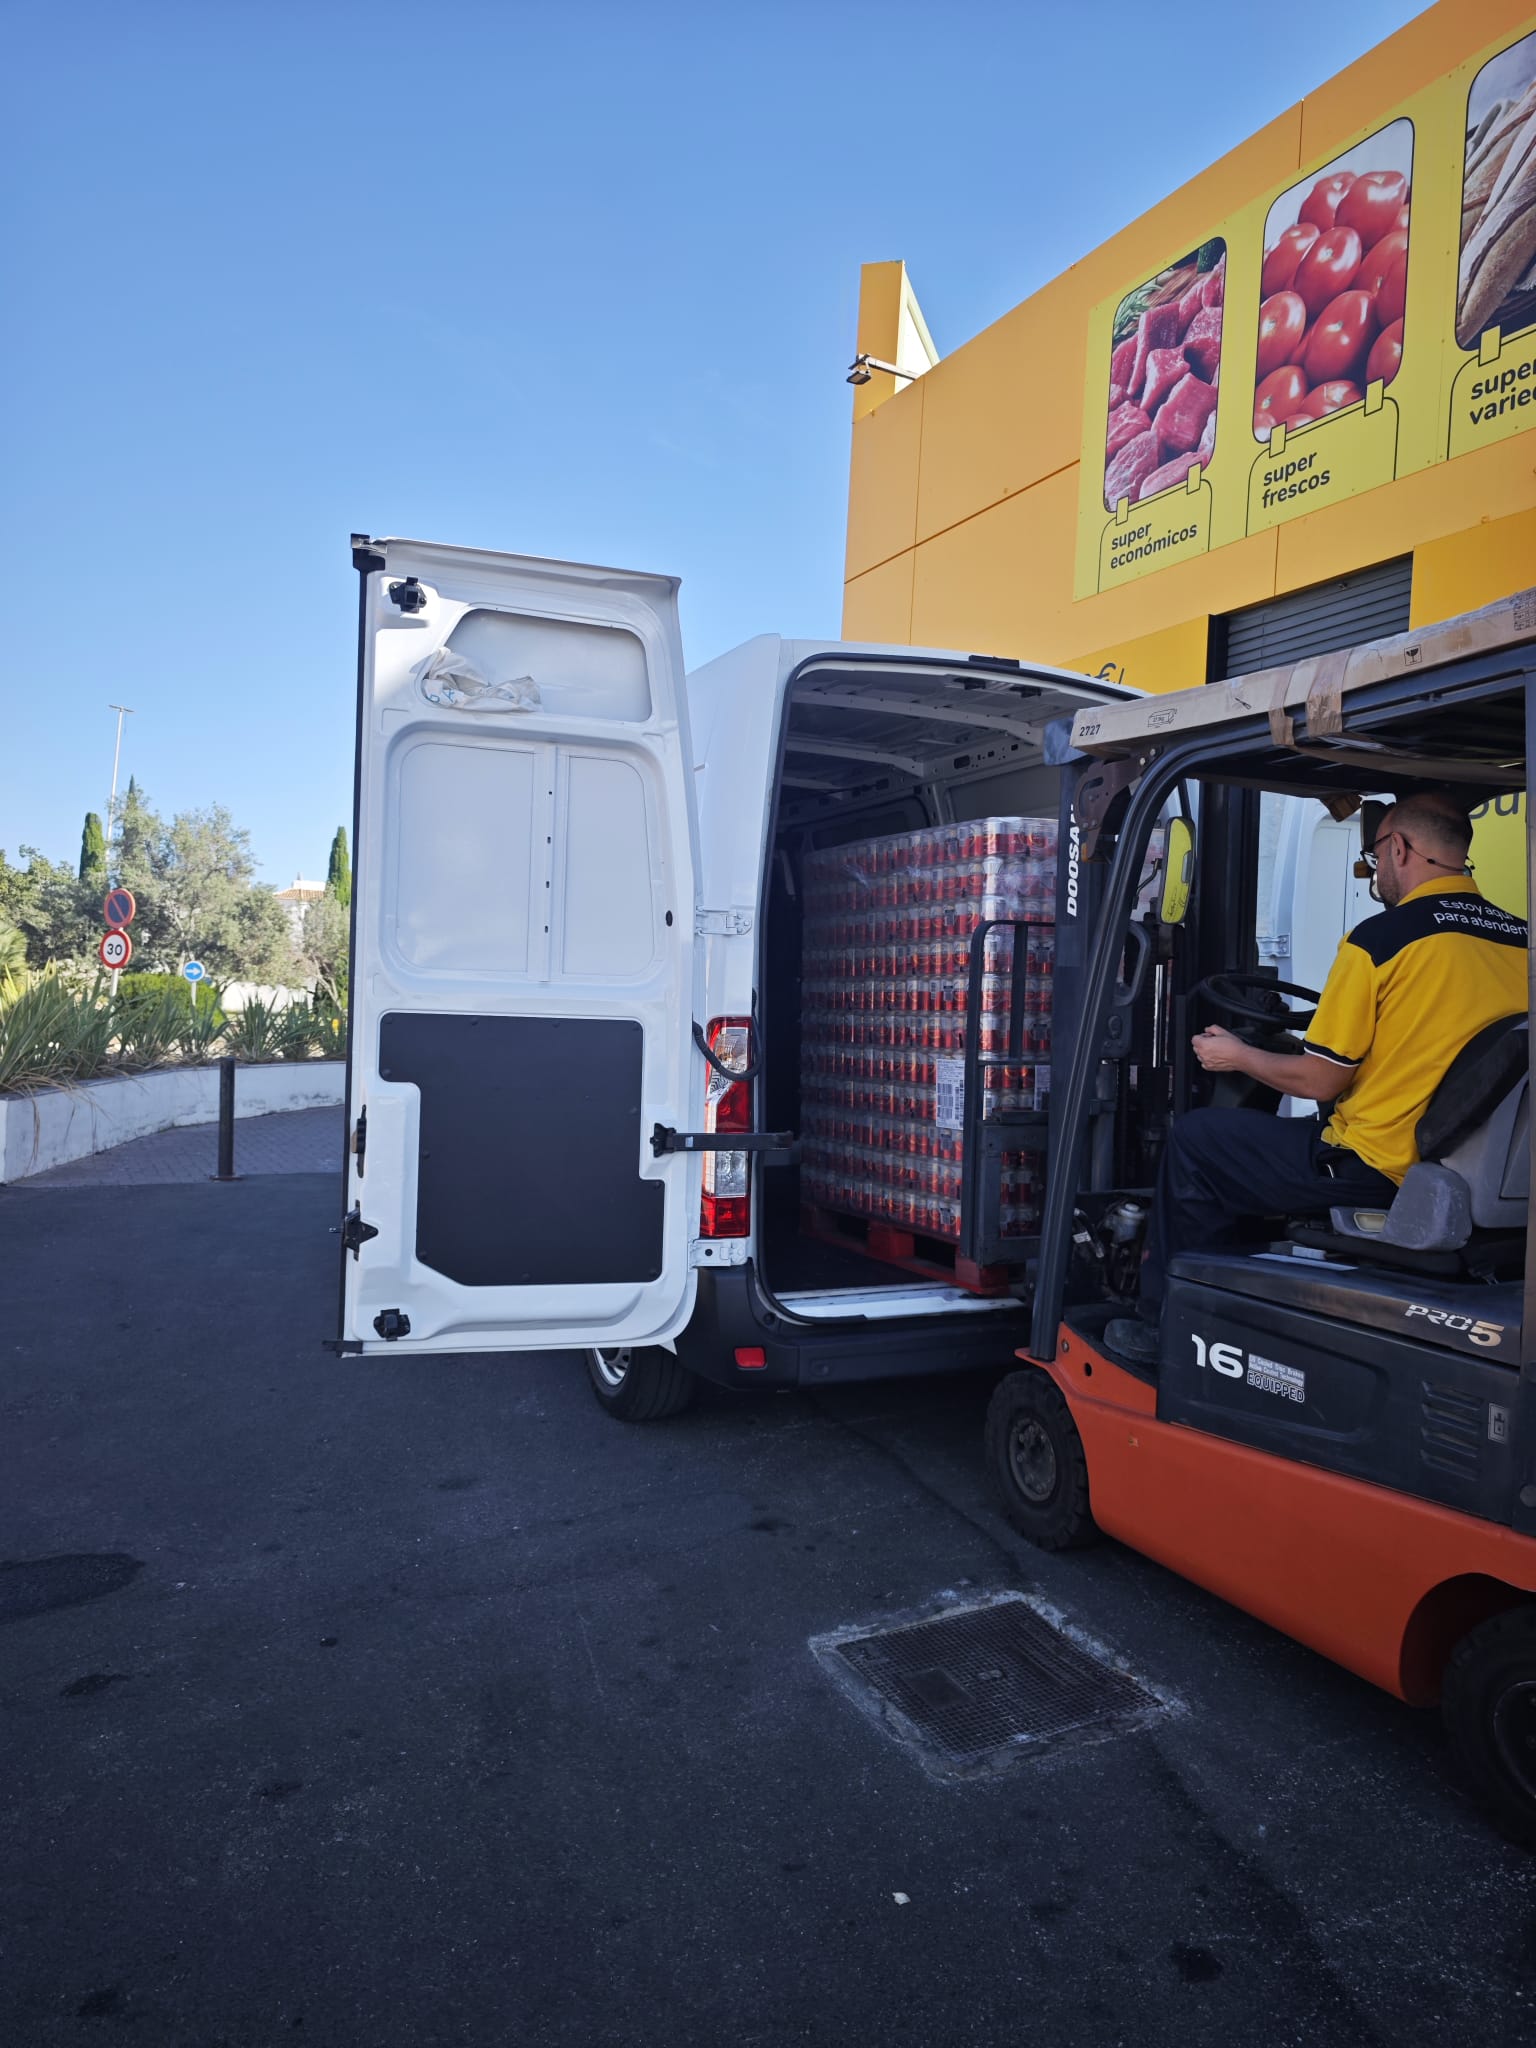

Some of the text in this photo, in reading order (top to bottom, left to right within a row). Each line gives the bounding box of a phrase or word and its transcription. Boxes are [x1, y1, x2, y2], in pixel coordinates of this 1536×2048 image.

[1263, 452, 1318, 486] super
[1262, 470, 1331, 509] frescos
[1110, 524, 1198, 570] económicos
[1111, 523, 1152, 551] super
[1079, 724, 1101, 737] 2727
[1066, 803, 1081, 917] DOOSA
[1433, 911, 1470, 925] para
[1439, 900, 1483, 916] Estoy
[106, 943, 123, 955] 30
[1191, 1333, 1244, 1379] 16
[1246, 1370, 1305, 1403] EQUIPPED
